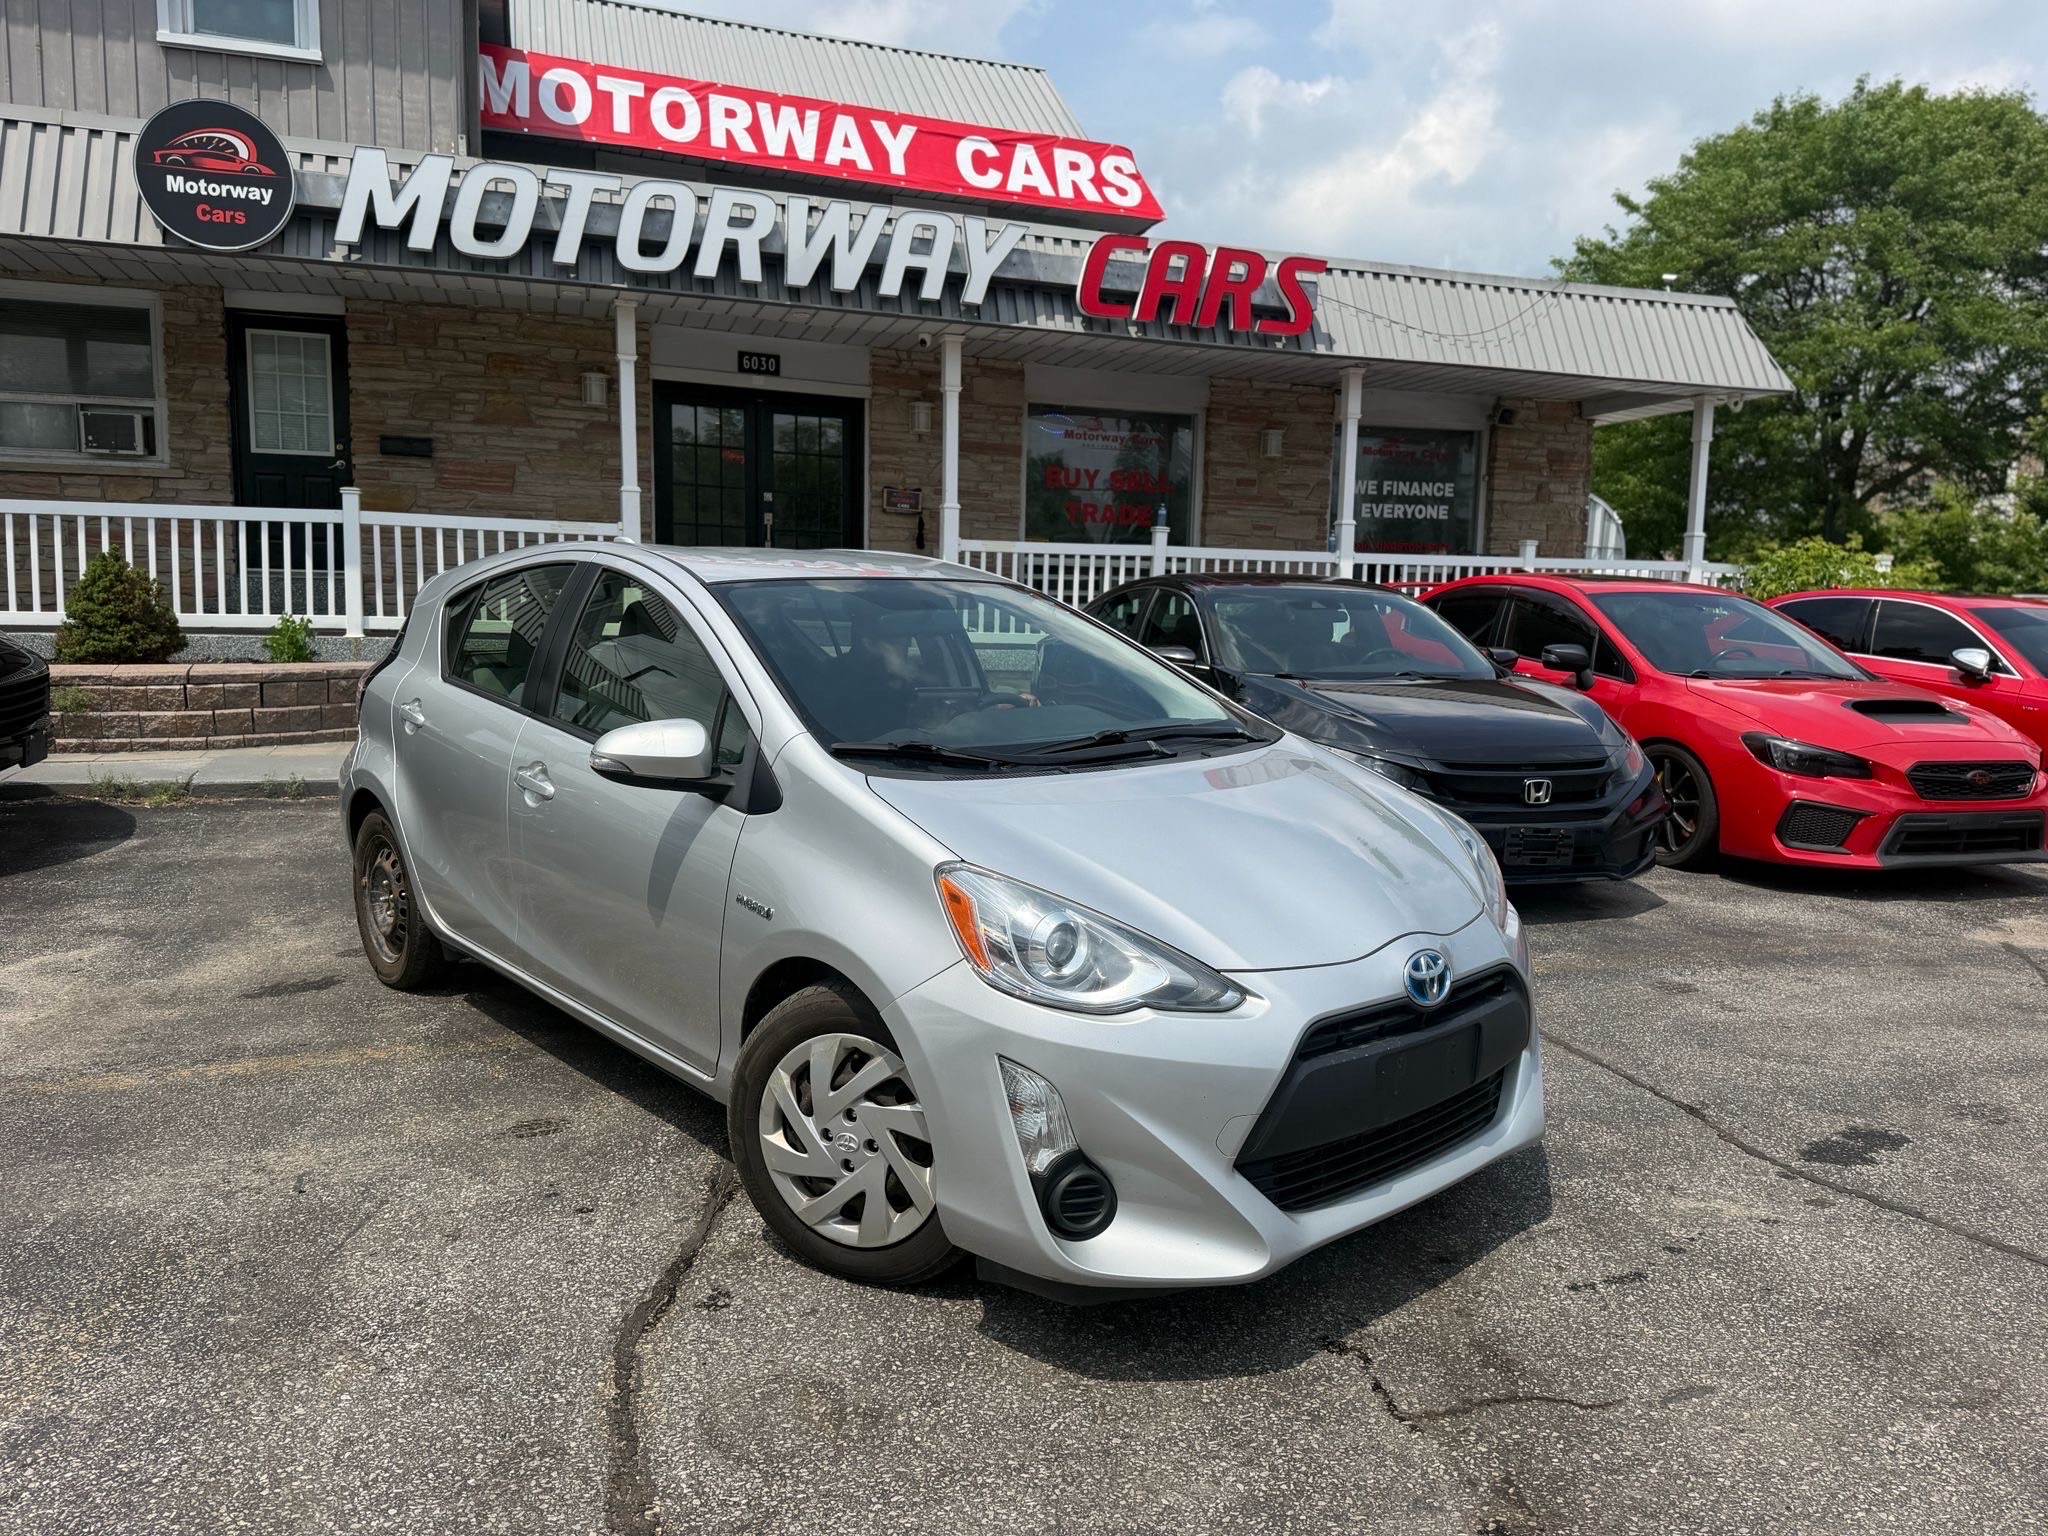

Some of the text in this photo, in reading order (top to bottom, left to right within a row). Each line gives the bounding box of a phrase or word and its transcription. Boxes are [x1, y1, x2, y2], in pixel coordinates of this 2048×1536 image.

[480, 53, 1143, 208] MOTORWAY CARS
[166, 174, 273, 205] Motorway
[196, 203, 246, 224] Cars
[334, 146, 1328, 337] MOTORWAY CARS
[743, 355, 776, 371] 6030
[1063, 429, 1126, 444] Motorway
[1045, 465, 1173, 493] BUY SELL
[1354, 480, 1455, 497] WE FINANCE
[1064, 500, 1152, 527] TRADE
[1361, 503, 1449, 520] EVERYONE
